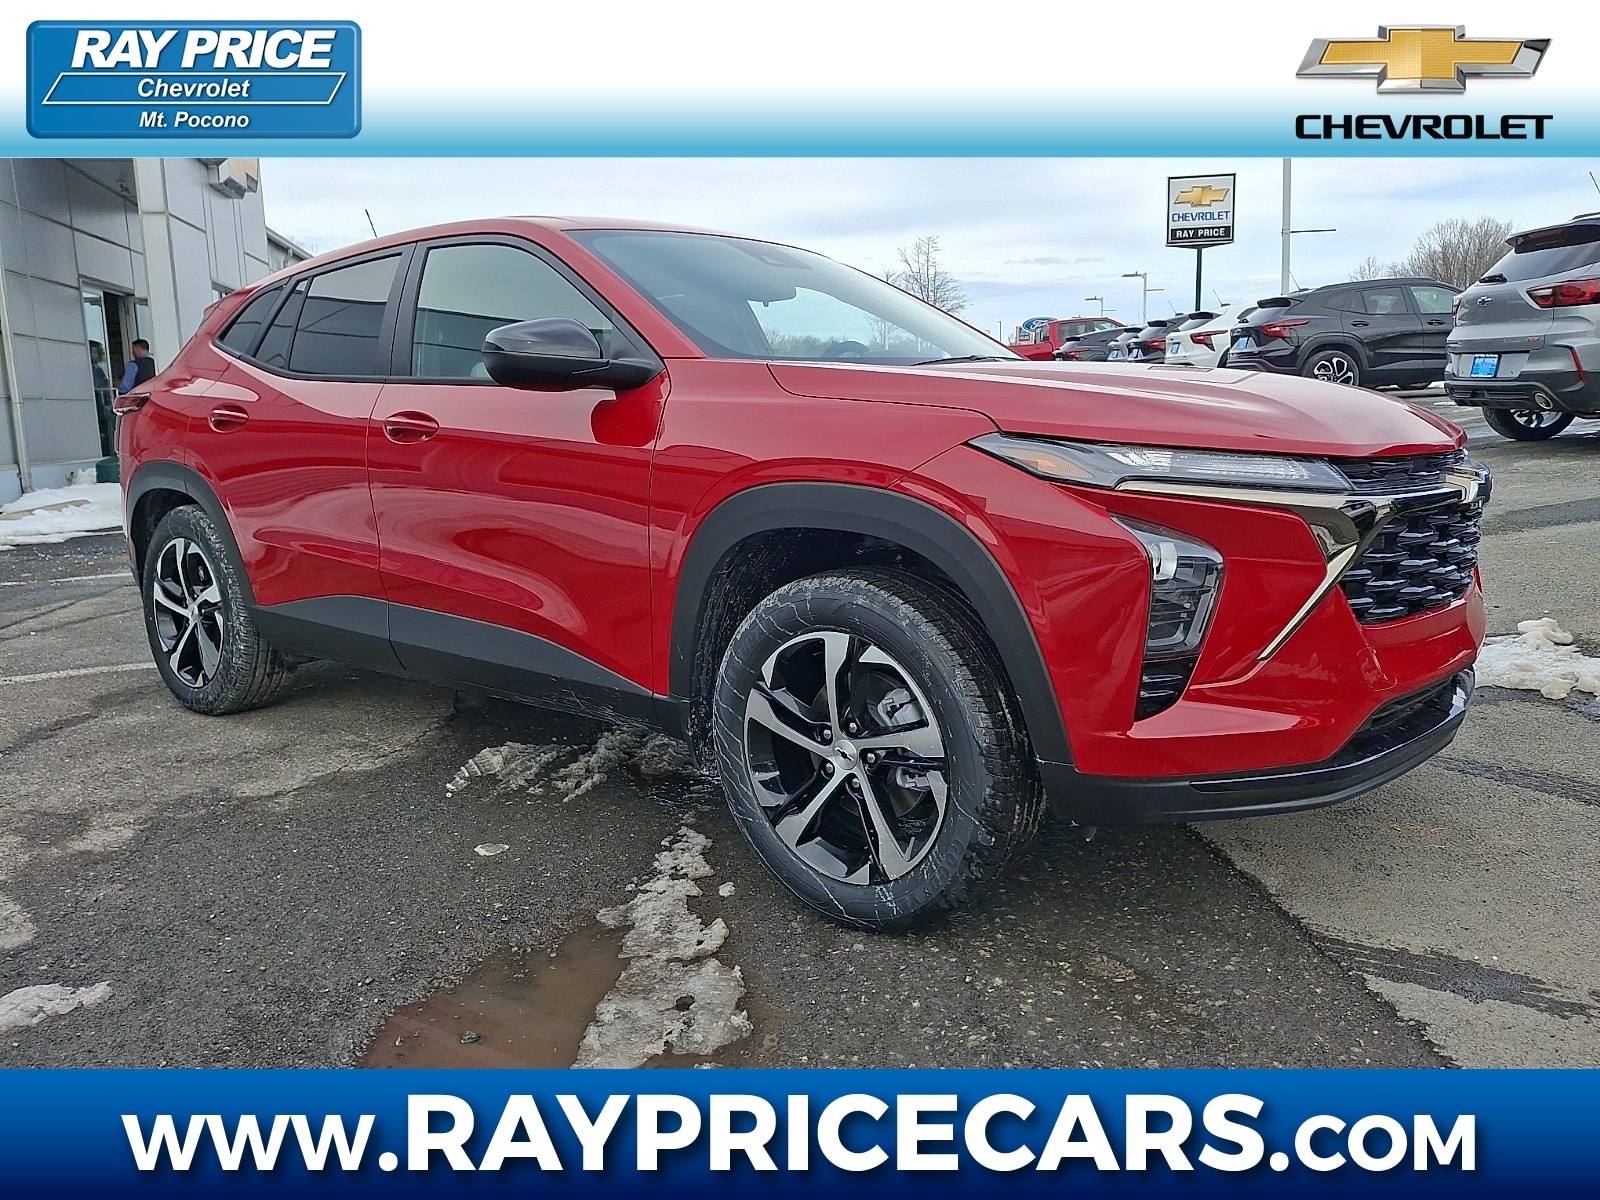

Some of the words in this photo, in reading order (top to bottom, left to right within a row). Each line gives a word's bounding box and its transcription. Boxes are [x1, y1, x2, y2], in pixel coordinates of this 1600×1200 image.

[1171, 210, 1231, 222] CHEVROLET
[1176, 229, 1194, 239] RAY
[1197, 227, 1226, 238] PRICE
